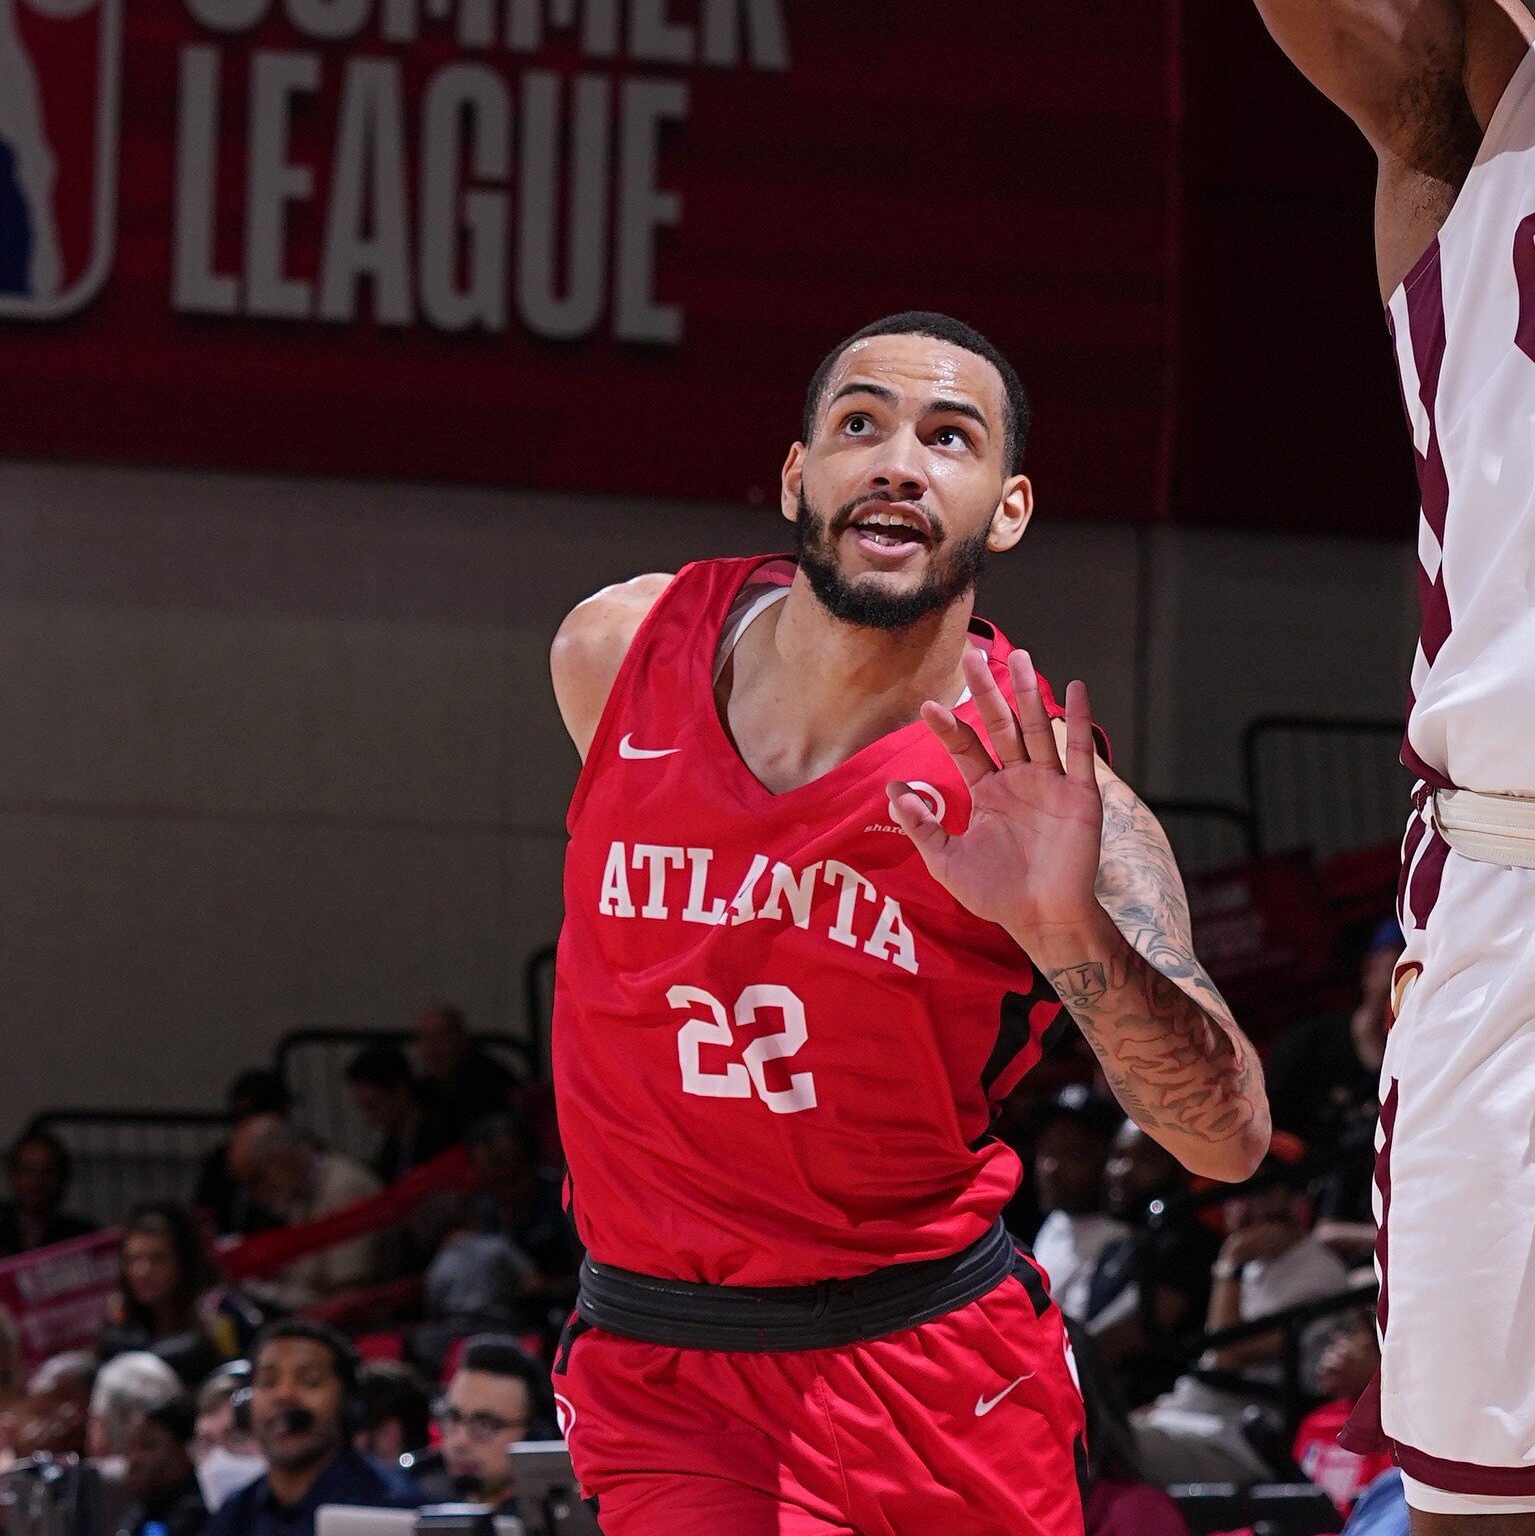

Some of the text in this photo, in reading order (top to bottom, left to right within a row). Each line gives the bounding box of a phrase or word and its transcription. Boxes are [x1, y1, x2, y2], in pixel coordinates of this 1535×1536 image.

[170, 42, 690, 345] LEAGUE
[599, 840, 918, 976] ATLANTA
[666, 984, 817, 1114] 22
